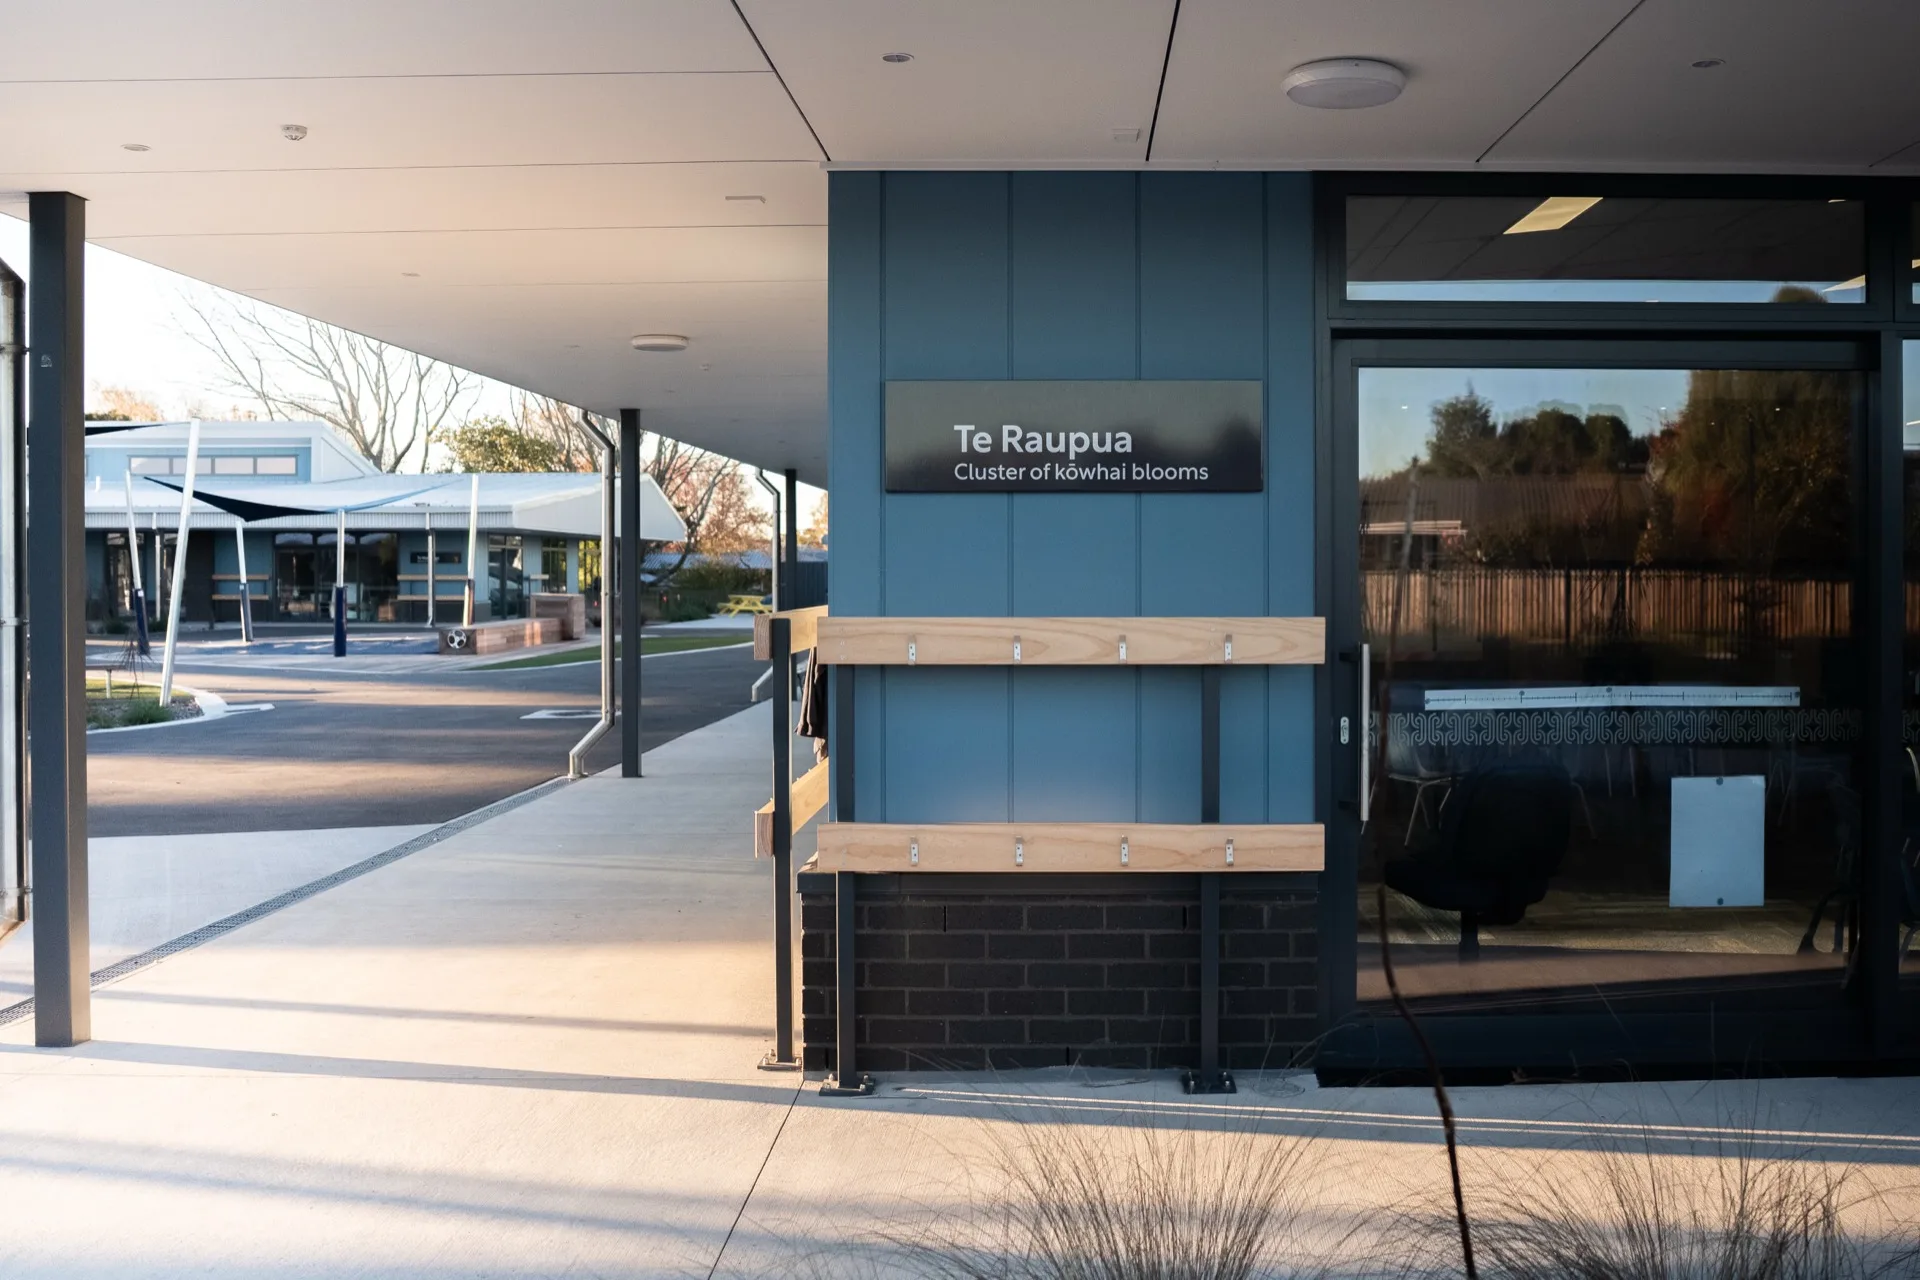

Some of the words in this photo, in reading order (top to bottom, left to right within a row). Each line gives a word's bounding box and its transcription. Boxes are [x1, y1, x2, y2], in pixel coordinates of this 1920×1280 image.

[953, 424, 993, 453] Te
[1001, 424, 1133, 460] Raupua
[953, 462, 1026, 481] Cluster
[1029, 462, 1052, 481] of
[1055, 462, 1126, 481] kōwhai
[1132, 462, 1209, 481] blooms
